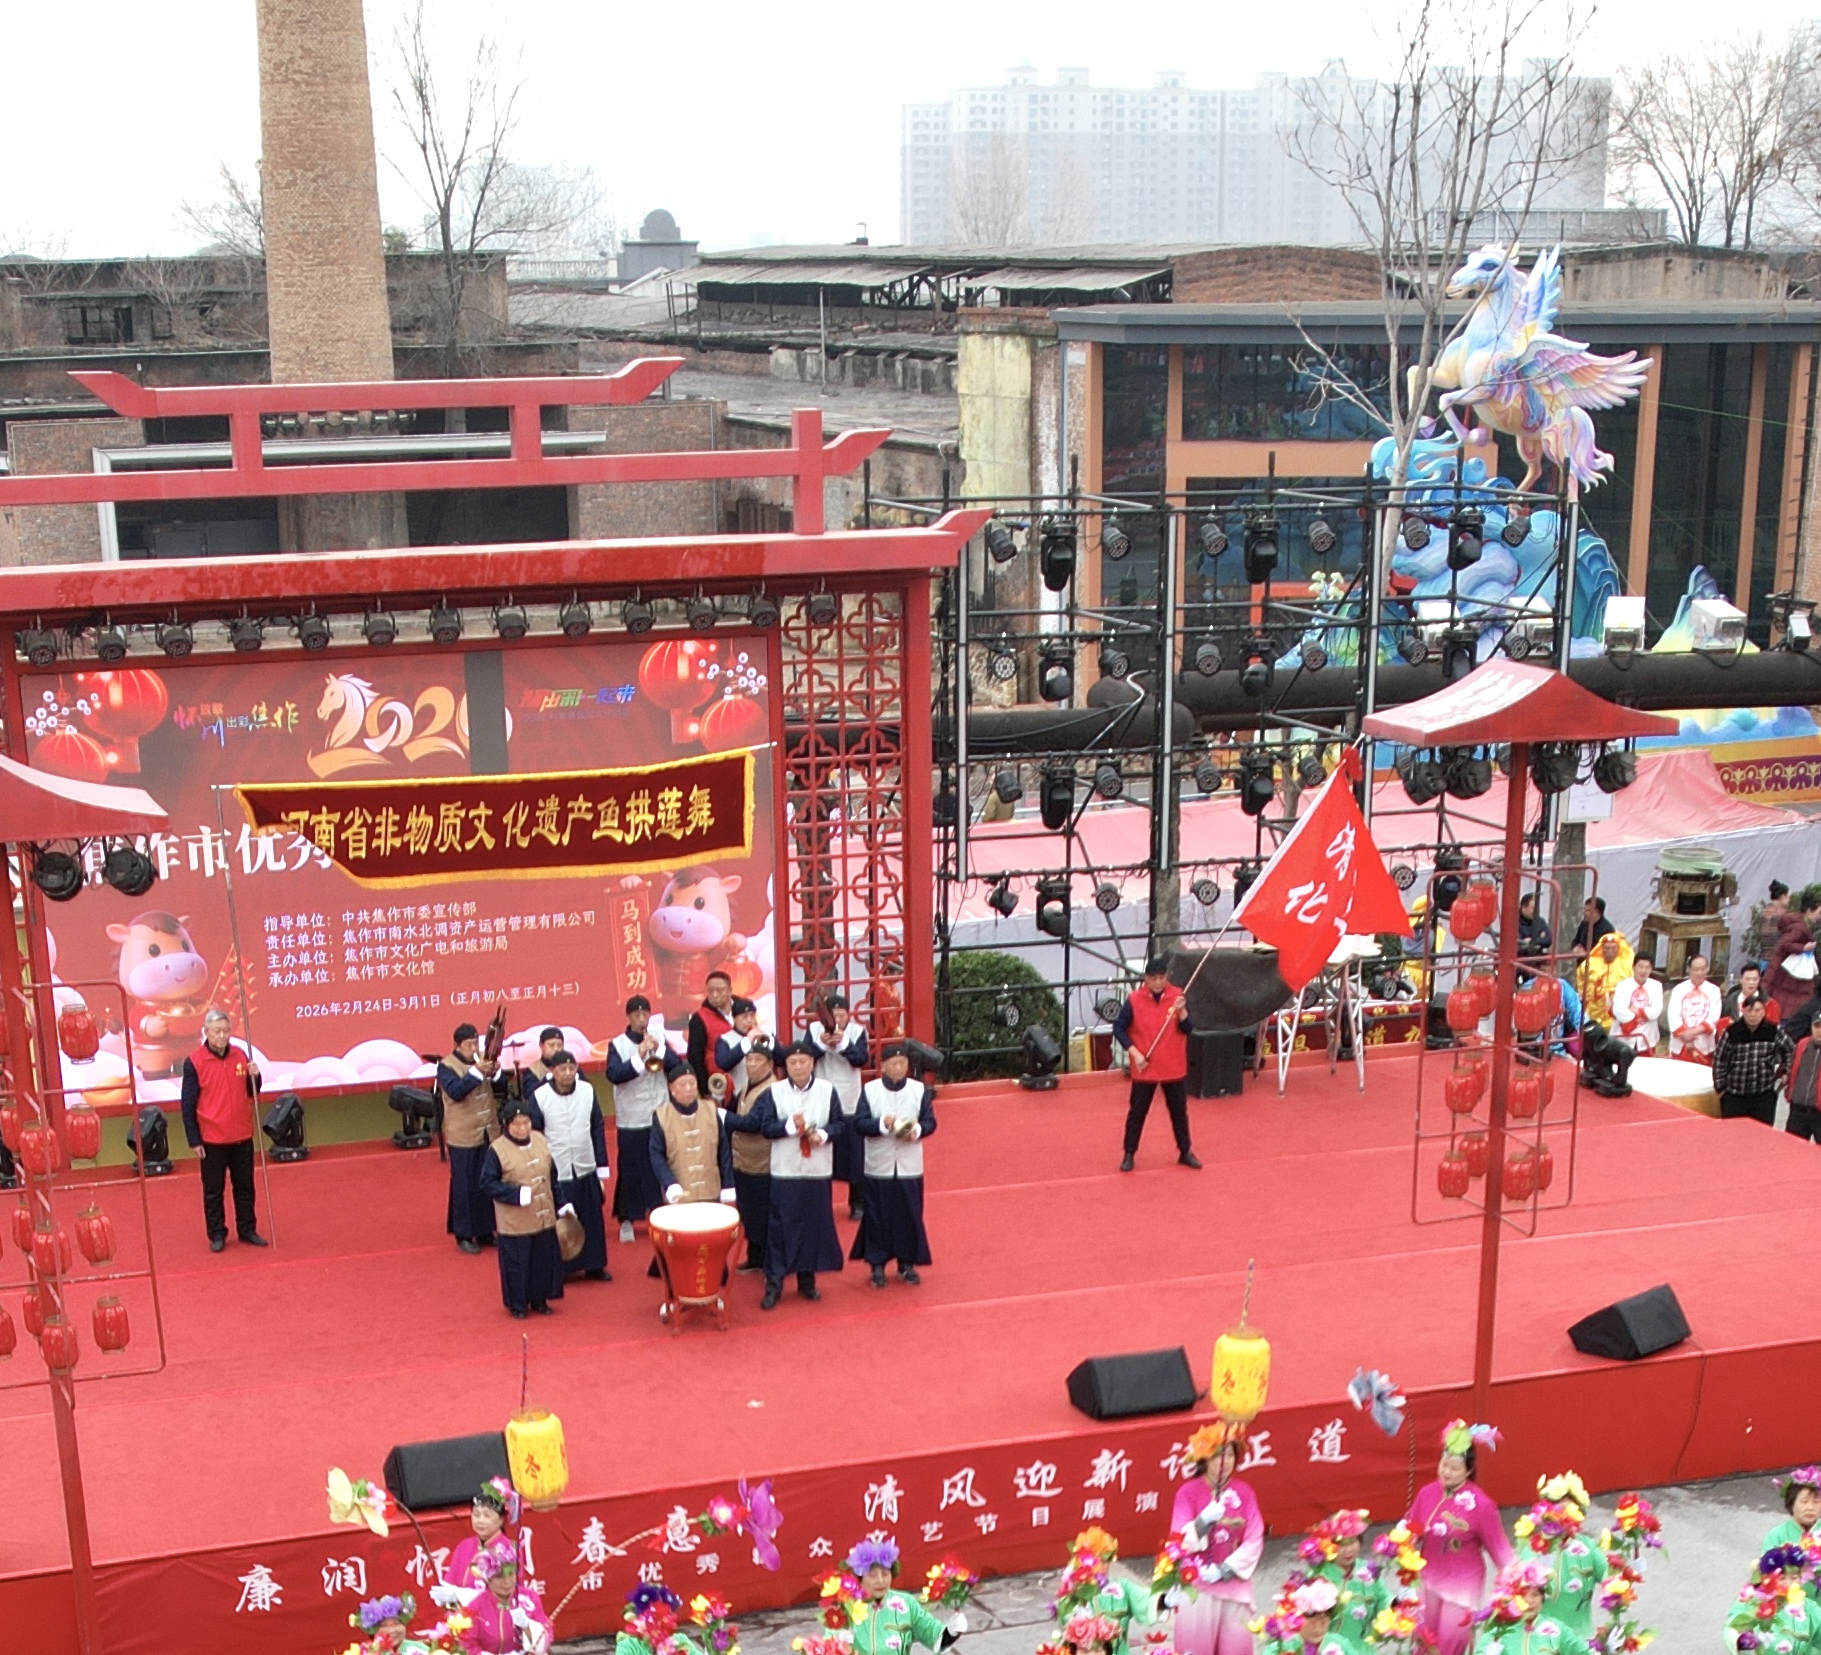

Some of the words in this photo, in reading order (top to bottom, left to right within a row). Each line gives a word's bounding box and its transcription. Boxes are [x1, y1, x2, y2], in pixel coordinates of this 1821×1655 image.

[281, 786, 718, 860] 河南省非物质文化遗产鱼拱莲舞
[621, 898, 648, 991] 马到成功
[524, 1453, 541, 1480] 冬
[235, 1497, 775, 1612] 廉润怀春意
[523, 1491, 1159, 1596] 作市优秀众文艺节目展演
